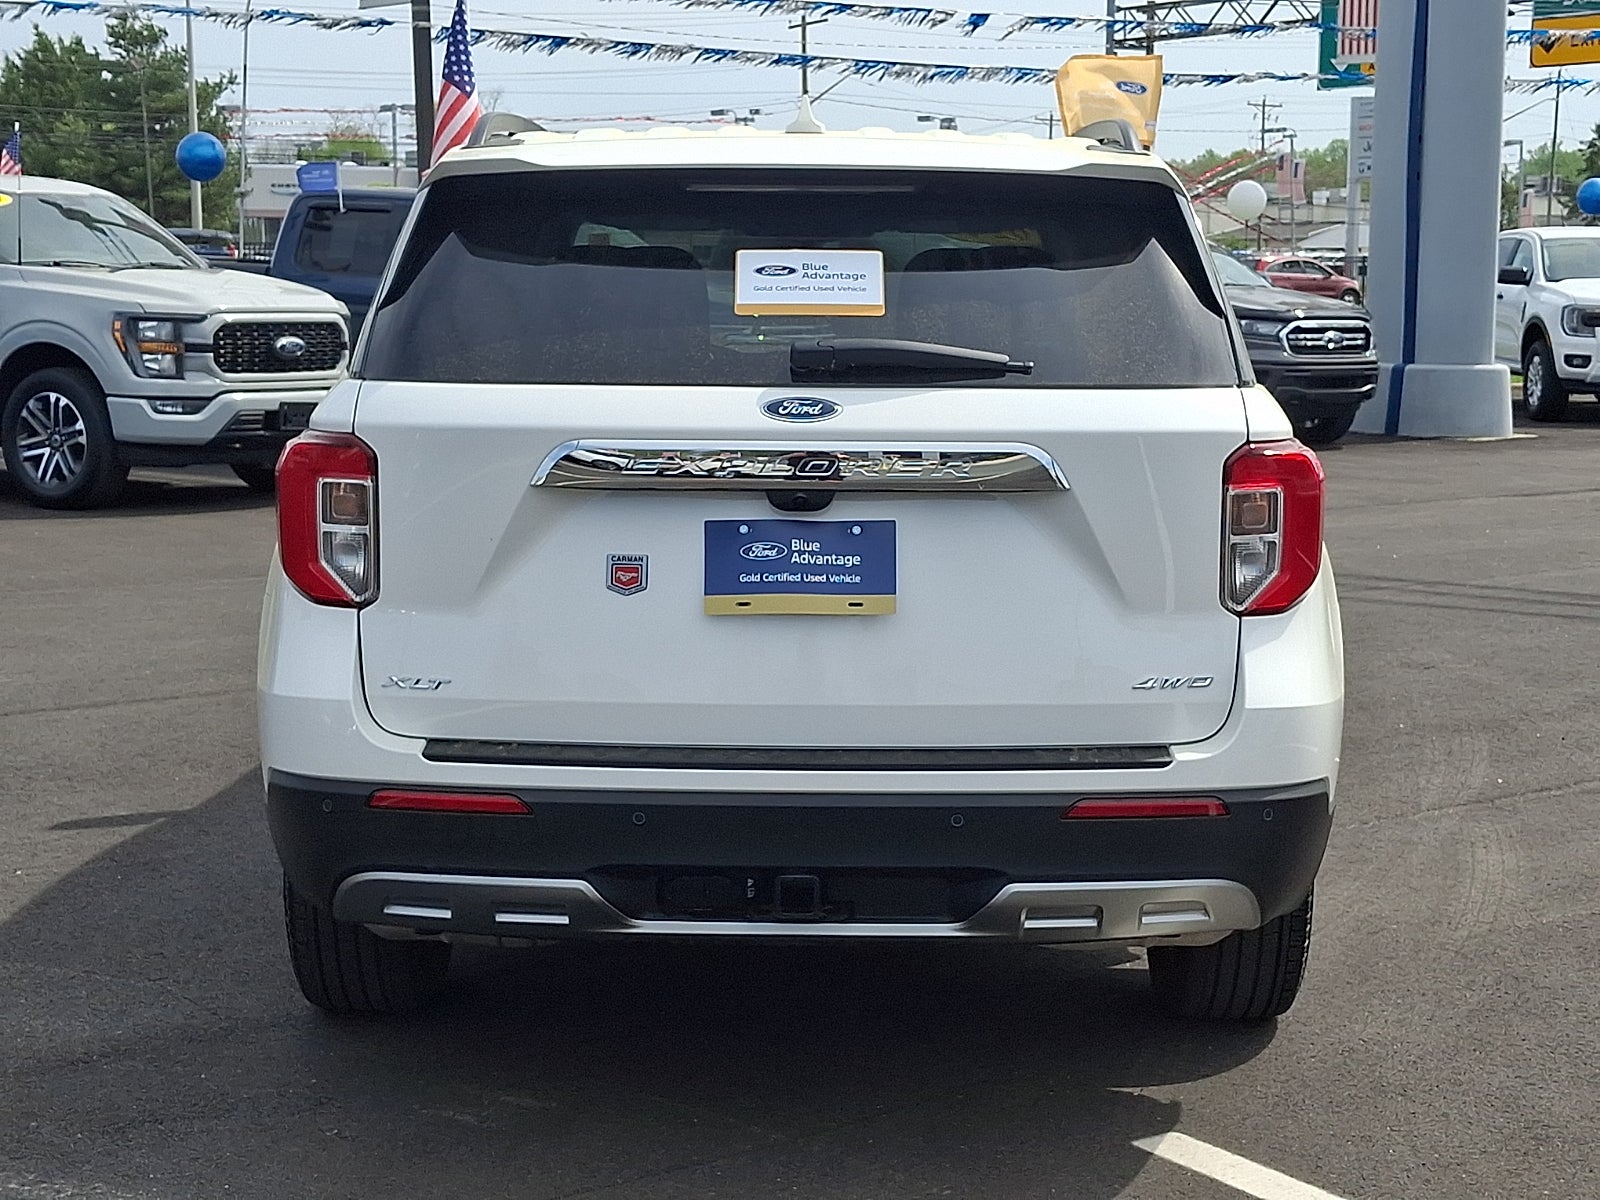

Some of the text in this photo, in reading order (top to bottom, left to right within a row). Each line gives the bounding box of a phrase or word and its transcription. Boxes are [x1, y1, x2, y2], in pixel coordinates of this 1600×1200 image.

[802, 263, 829, 271] Blue
[802, 272, 867, 281] Advantage
[621, 453, 975, 478] EXPLORER
[791, 538, 821, 552] Blue
[610, 555, 644, 563] CARMAN
[790, 552, 861, 567] Advantage
[739, 573, 861, 583] Gold Certified Used Vehicle
[381, 676, 452, 690] XLT
[1132, 676, 1214, 690] 4WD
